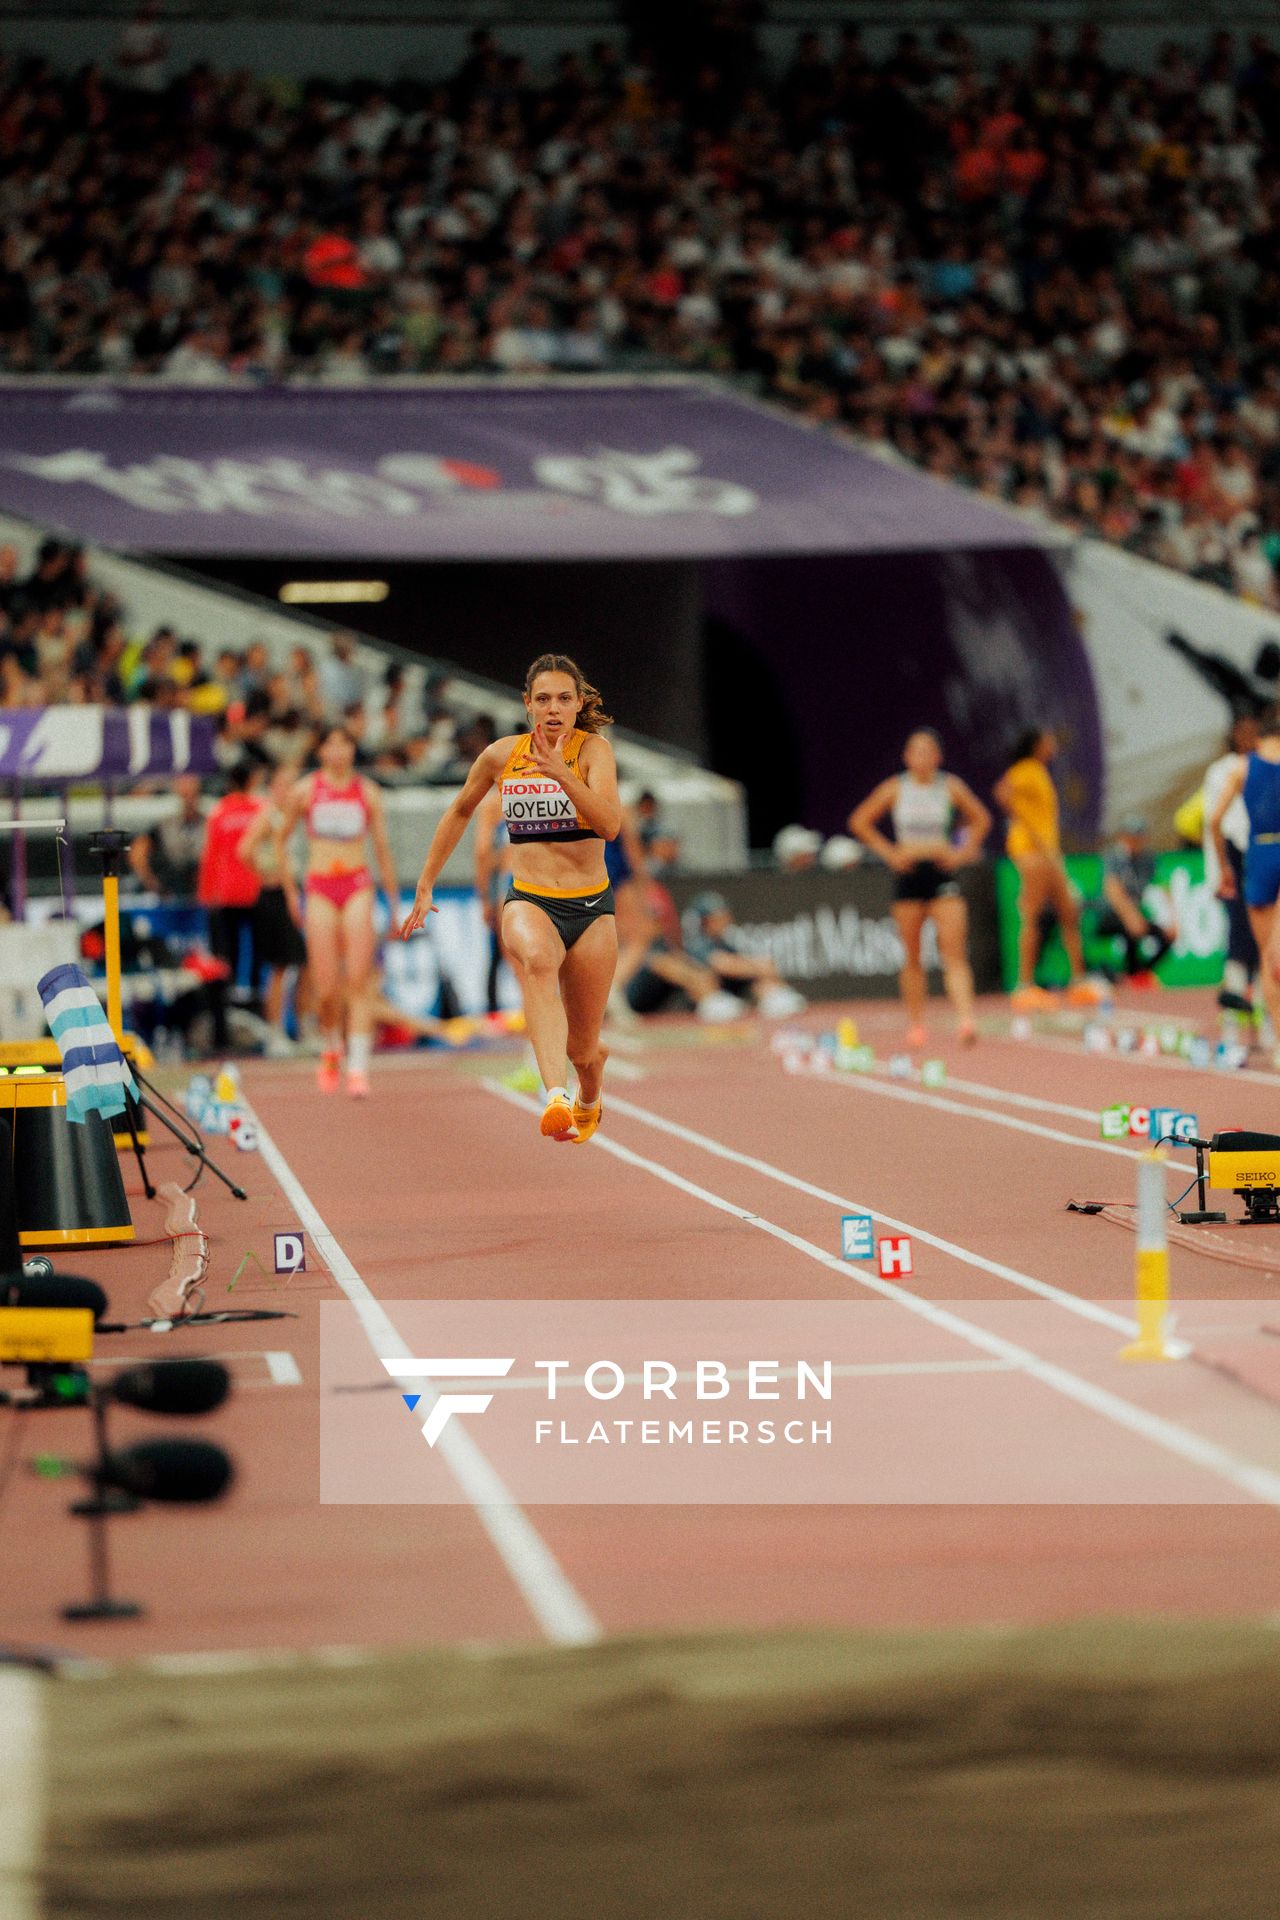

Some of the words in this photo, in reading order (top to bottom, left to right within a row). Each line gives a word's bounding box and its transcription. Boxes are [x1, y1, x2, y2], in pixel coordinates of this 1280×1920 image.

[505, 800, 571, 818] JOYEUX
[1236, 1172, 1277, 1182] SEIKO
[275, 1235, 304, 1269] D
[843, 1219, 871, 1253] E
[880, 1239, 912, 1273] H
